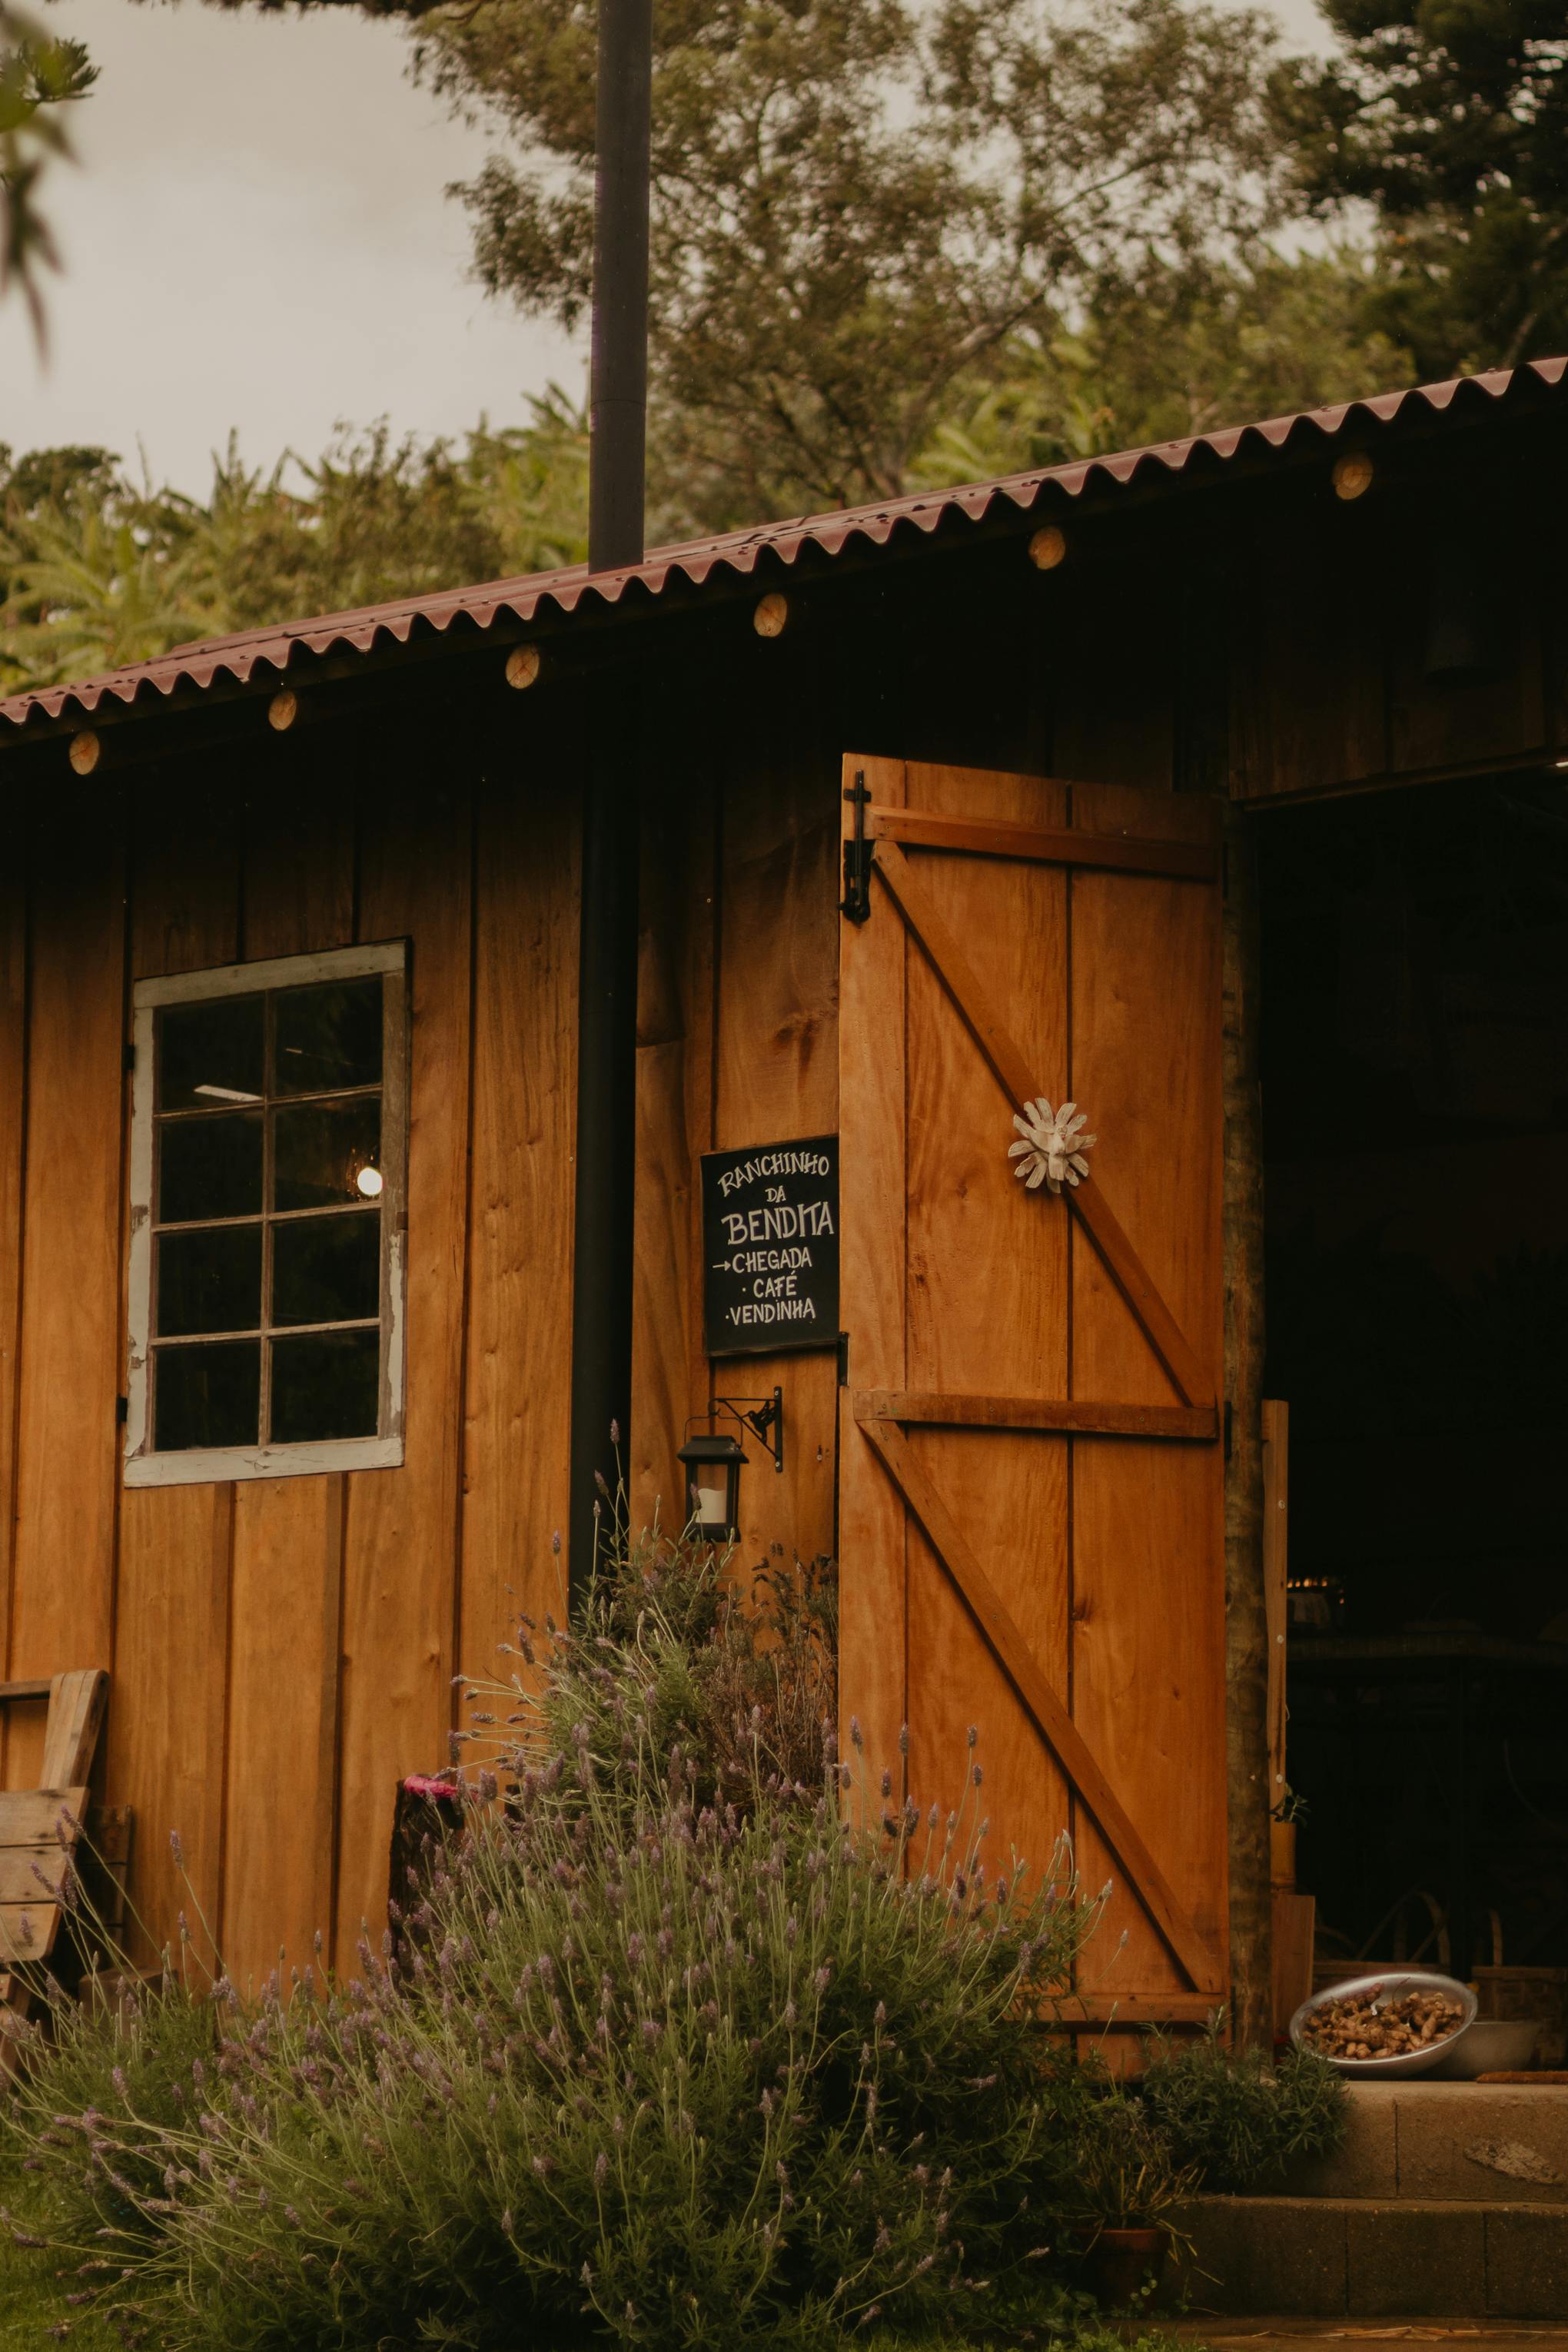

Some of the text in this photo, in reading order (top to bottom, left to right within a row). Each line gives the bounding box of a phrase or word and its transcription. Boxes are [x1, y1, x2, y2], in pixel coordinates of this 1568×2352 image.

[718, 1151, 829, 1197] RANCHINHO
[765, 1185, 787, 1203] DA
[721, 1201, 835, 1244] BENDITA
[732, 1247, 812, 1274] CHEGADA
[752, 1270, 798, 1298] CAFÉ
[730, 1297, 816, 1326] VENDINHA
